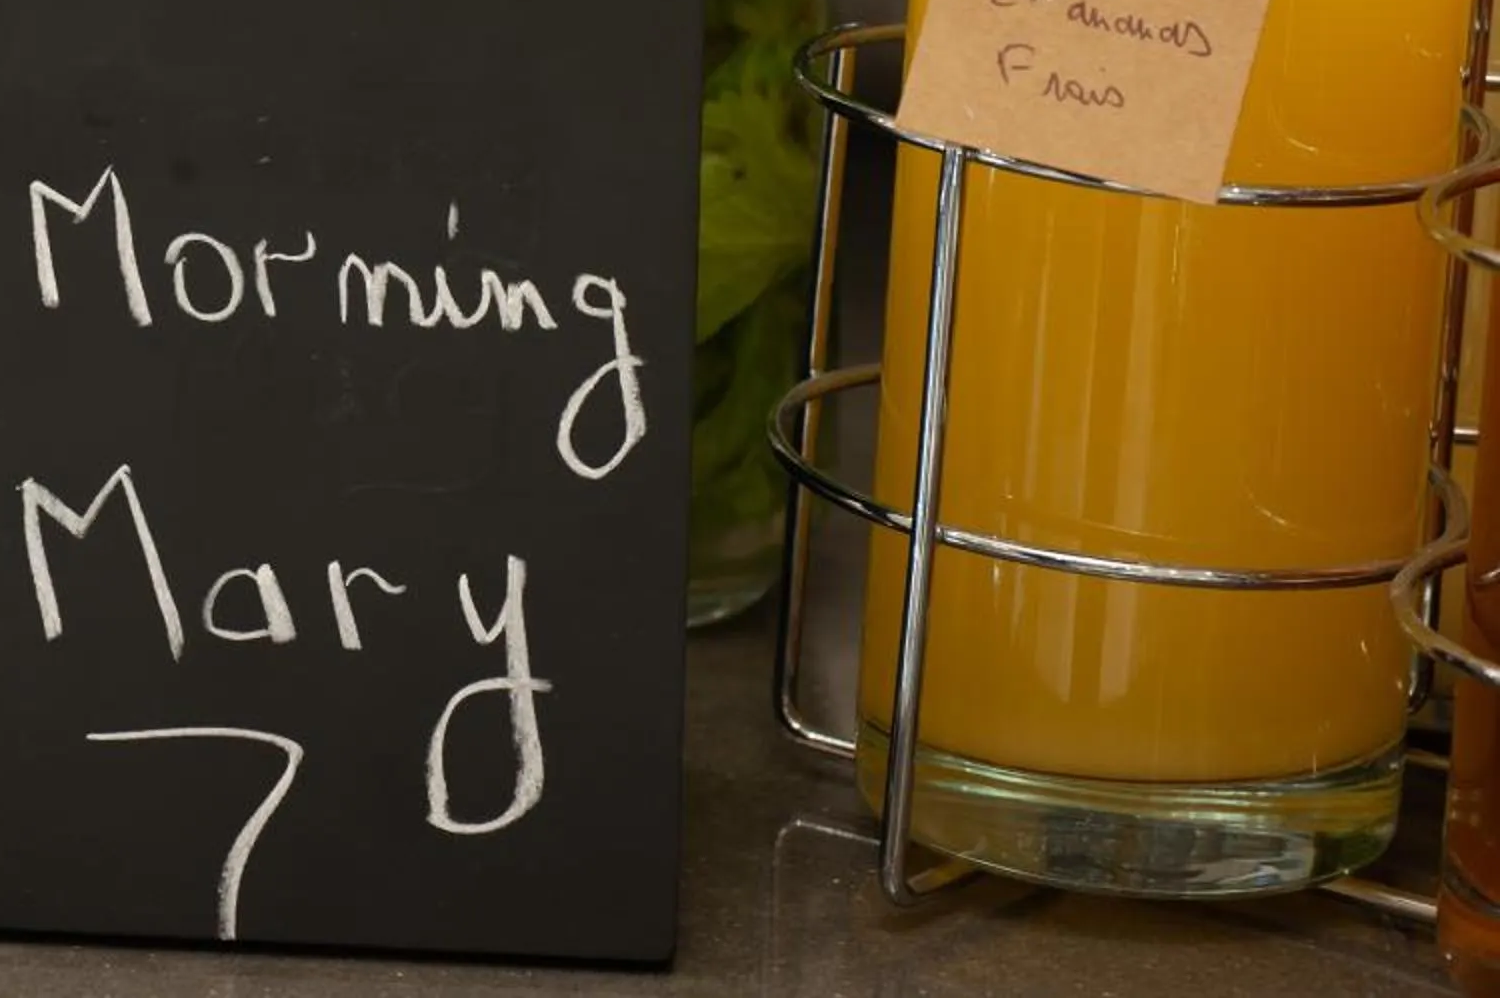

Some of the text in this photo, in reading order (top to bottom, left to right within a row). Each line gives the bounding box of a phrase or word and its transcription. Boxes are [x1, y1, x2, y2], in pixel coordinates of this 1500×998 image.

[996, 43, 1125, 110] Frais
[28, 164, 647, 480] Morning
[16, 463, 553, 835] Mary
